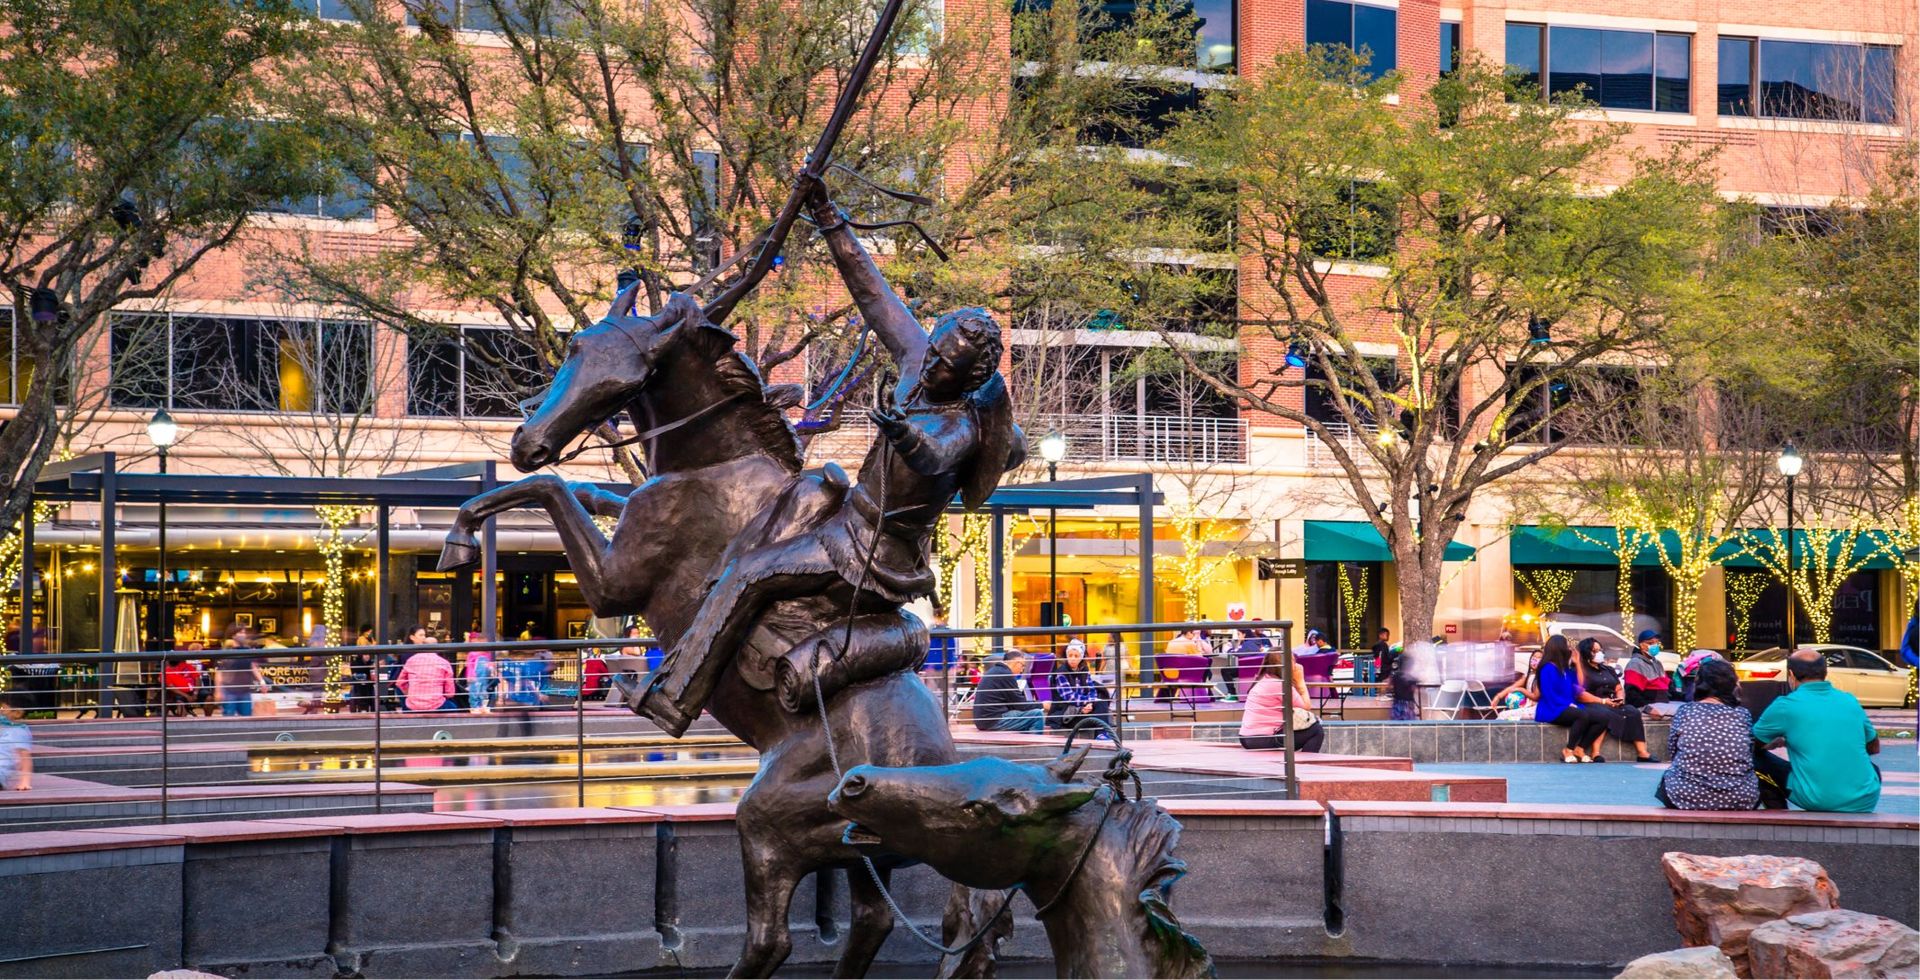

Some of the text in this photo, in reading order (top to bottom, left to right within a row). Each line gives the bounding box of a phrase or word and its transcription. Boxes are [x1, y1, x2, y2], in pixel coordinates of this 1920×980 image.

[260, 666, 309, 676] MORE WA
[272, 677, 309, 685] TO ORD
